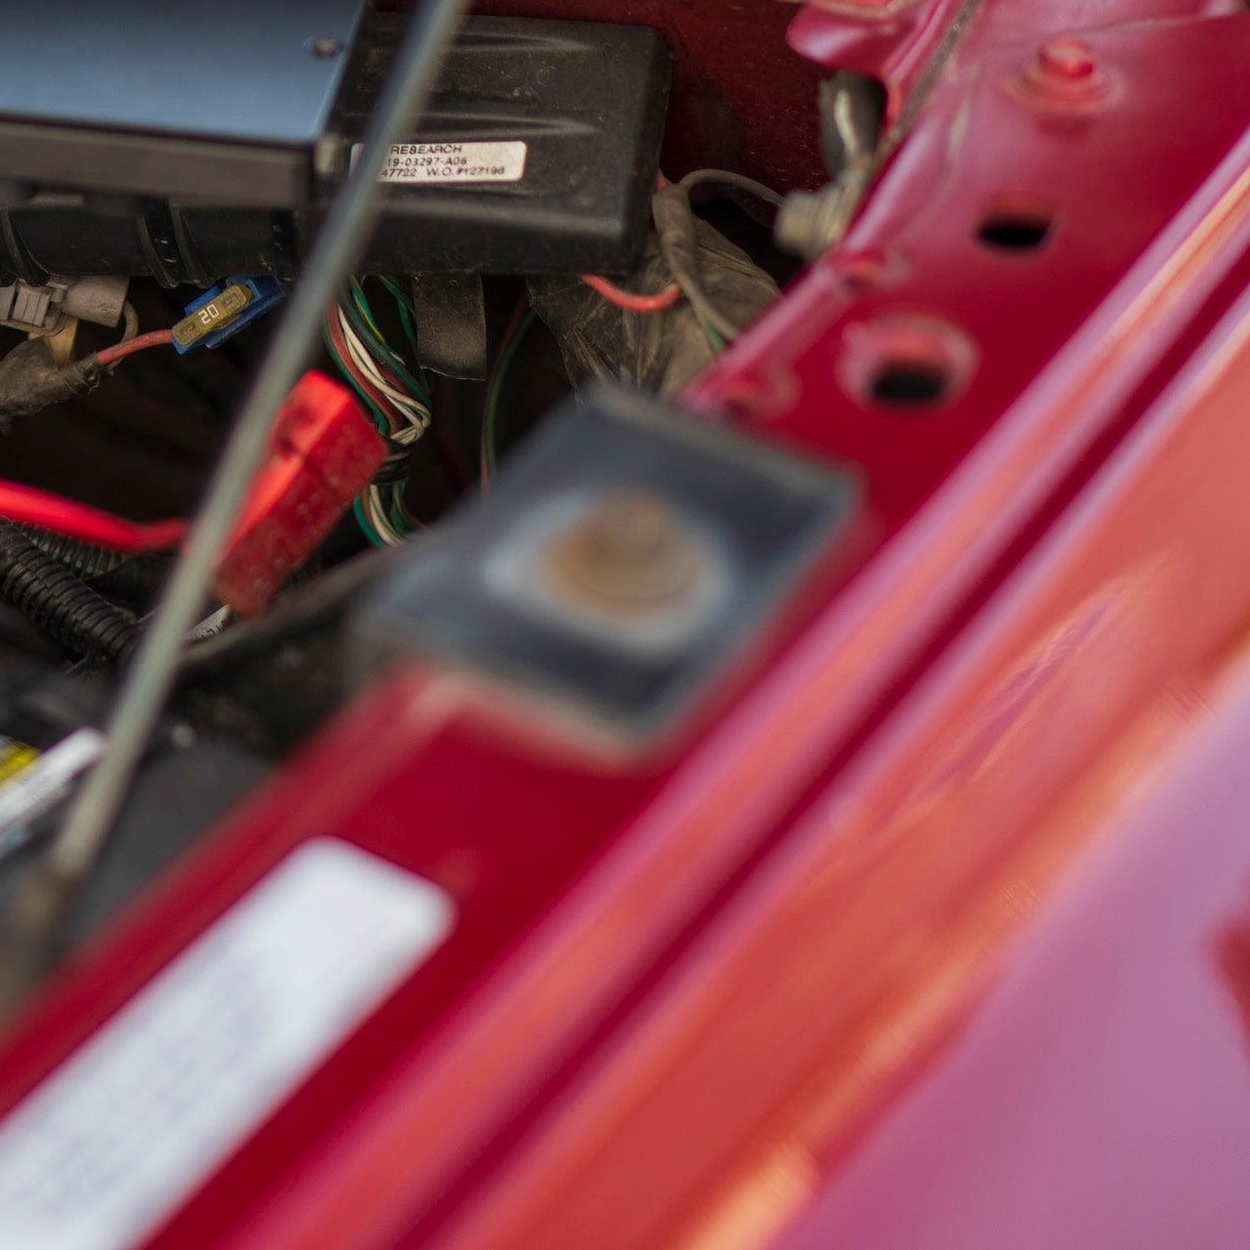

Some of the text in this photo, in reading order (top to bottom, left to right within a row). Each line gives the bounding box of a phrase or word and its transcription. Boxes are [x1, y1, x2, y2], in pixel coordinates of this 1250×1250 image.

[390, 145, 462, 155] RESEARCH
[426, 167, 453, 177] W.O.
[198, 303, 220, 325] 20
